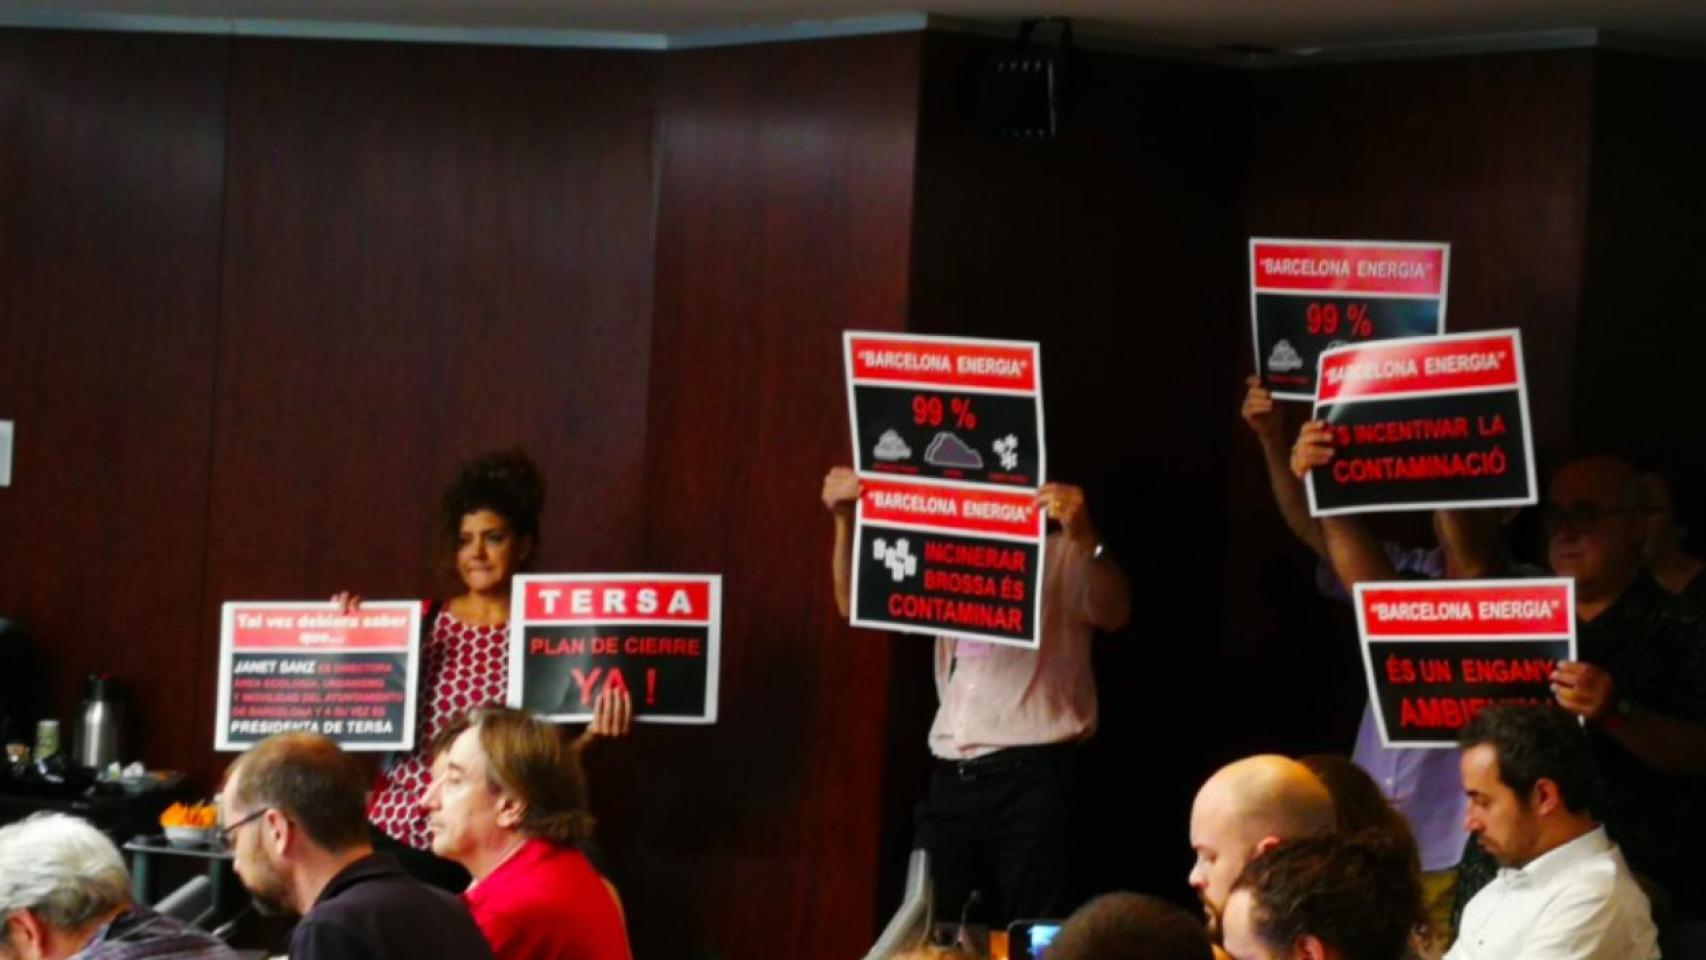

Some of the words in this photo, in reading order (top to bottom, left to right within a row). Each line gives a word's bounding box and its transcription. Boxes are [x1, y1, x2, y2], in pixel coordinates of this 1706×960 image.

[1306, 303, 1339, 335] 99
[1347, 304, 1373, 336] %
[912, 395, 943, 426] 99
[951, 397, 977, 430] %
[1354, 416, 1468, 444] INCENTIVAR
[1478, 414, 1507, 436] LA
[1333, 446, 1507, 483] CONTAMINACIÓ
[924, 541, 1026, 572] INCINERAR
[924, 569, 996, 596] BROSSA
[1001, 573, 1025, 600] ÉS
[538, 588, 693, 615] TERSA
[888, 593, 1023, 632] CONTAMINAR
[236, 613, 263, 630] Tal
[266, 616, 293, 629] vez
[298, 612, 359, 630] debiera
[362, 612, 408, 629] saber
[530, 637, 585, 656] PLAN
[592, 637, 619, 655] DE
[624, 638, 701, 656] CIERRE
[234, 660, 278, 674] JANET
[279, 660, 317, 674] SANZ
[1385, 653, 1416, 683] ÉS
[1419, 659, 1451, 682] UN
[570, 667, 628, 706] YA
[323, 720, 344, 735] DE
[347, 720, 394, 734] TERSA
